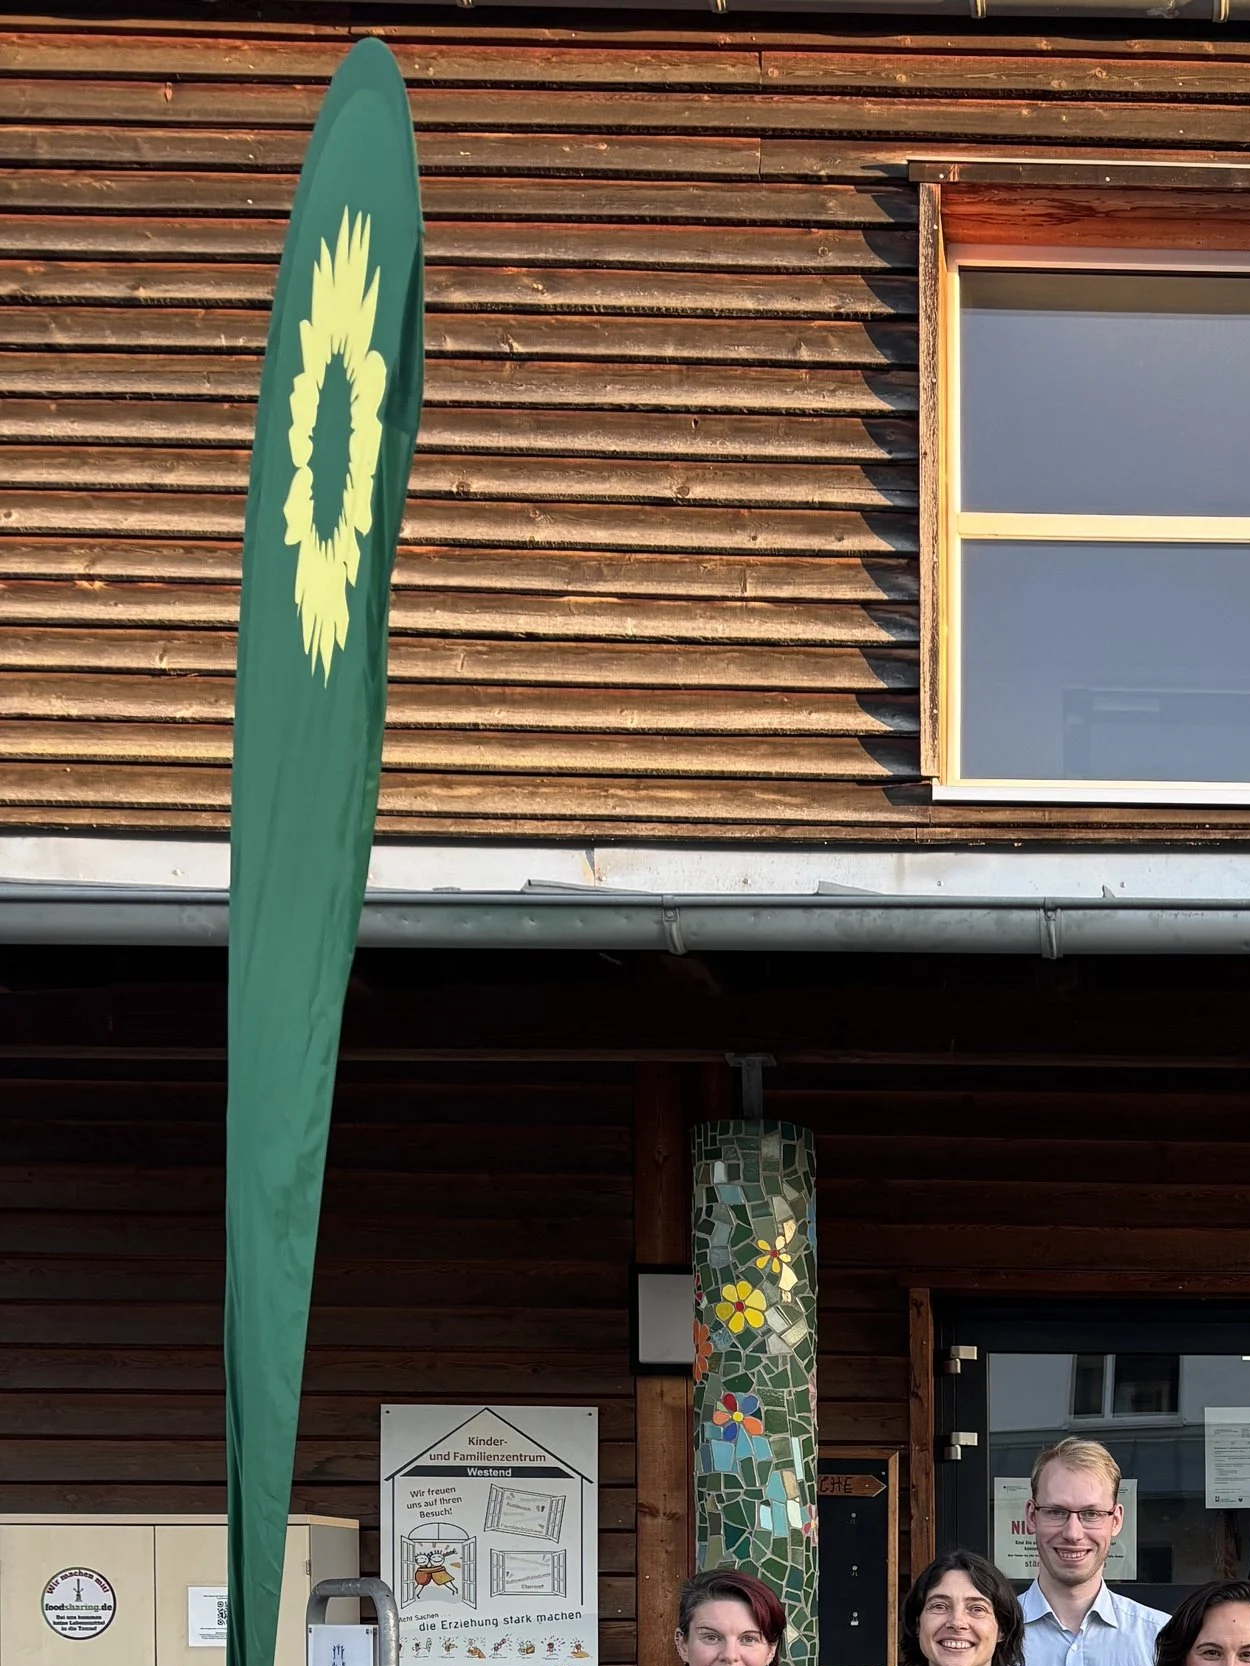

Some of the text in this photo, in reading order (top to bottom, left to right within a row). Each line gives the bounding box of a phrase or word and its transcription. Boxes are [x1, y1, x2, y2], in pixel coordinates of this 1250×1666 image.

[468, 1436, 508, 1446] Kinder-
[429, 1452, 546, 1462] und Familienzentrum
[467, 1467, 512, 1477] Westend
[820, 1476, 854, 1493] CHE
[409, 1487, 456, 1498] Wir freuen
[406, 1496, 462, 1510] uns auf Ihren
[419, 1508, 453, 1519] Besuch!
[46, 1579, 60, 1595] Wir
[60, 1569, 94, 1581] machen
[45, 1603, 112, 1612] foodsharing.de
[414, 1613, 439, 1621] Sachen
[418, 1611, 582, 1632] die Erziehung stark machen
